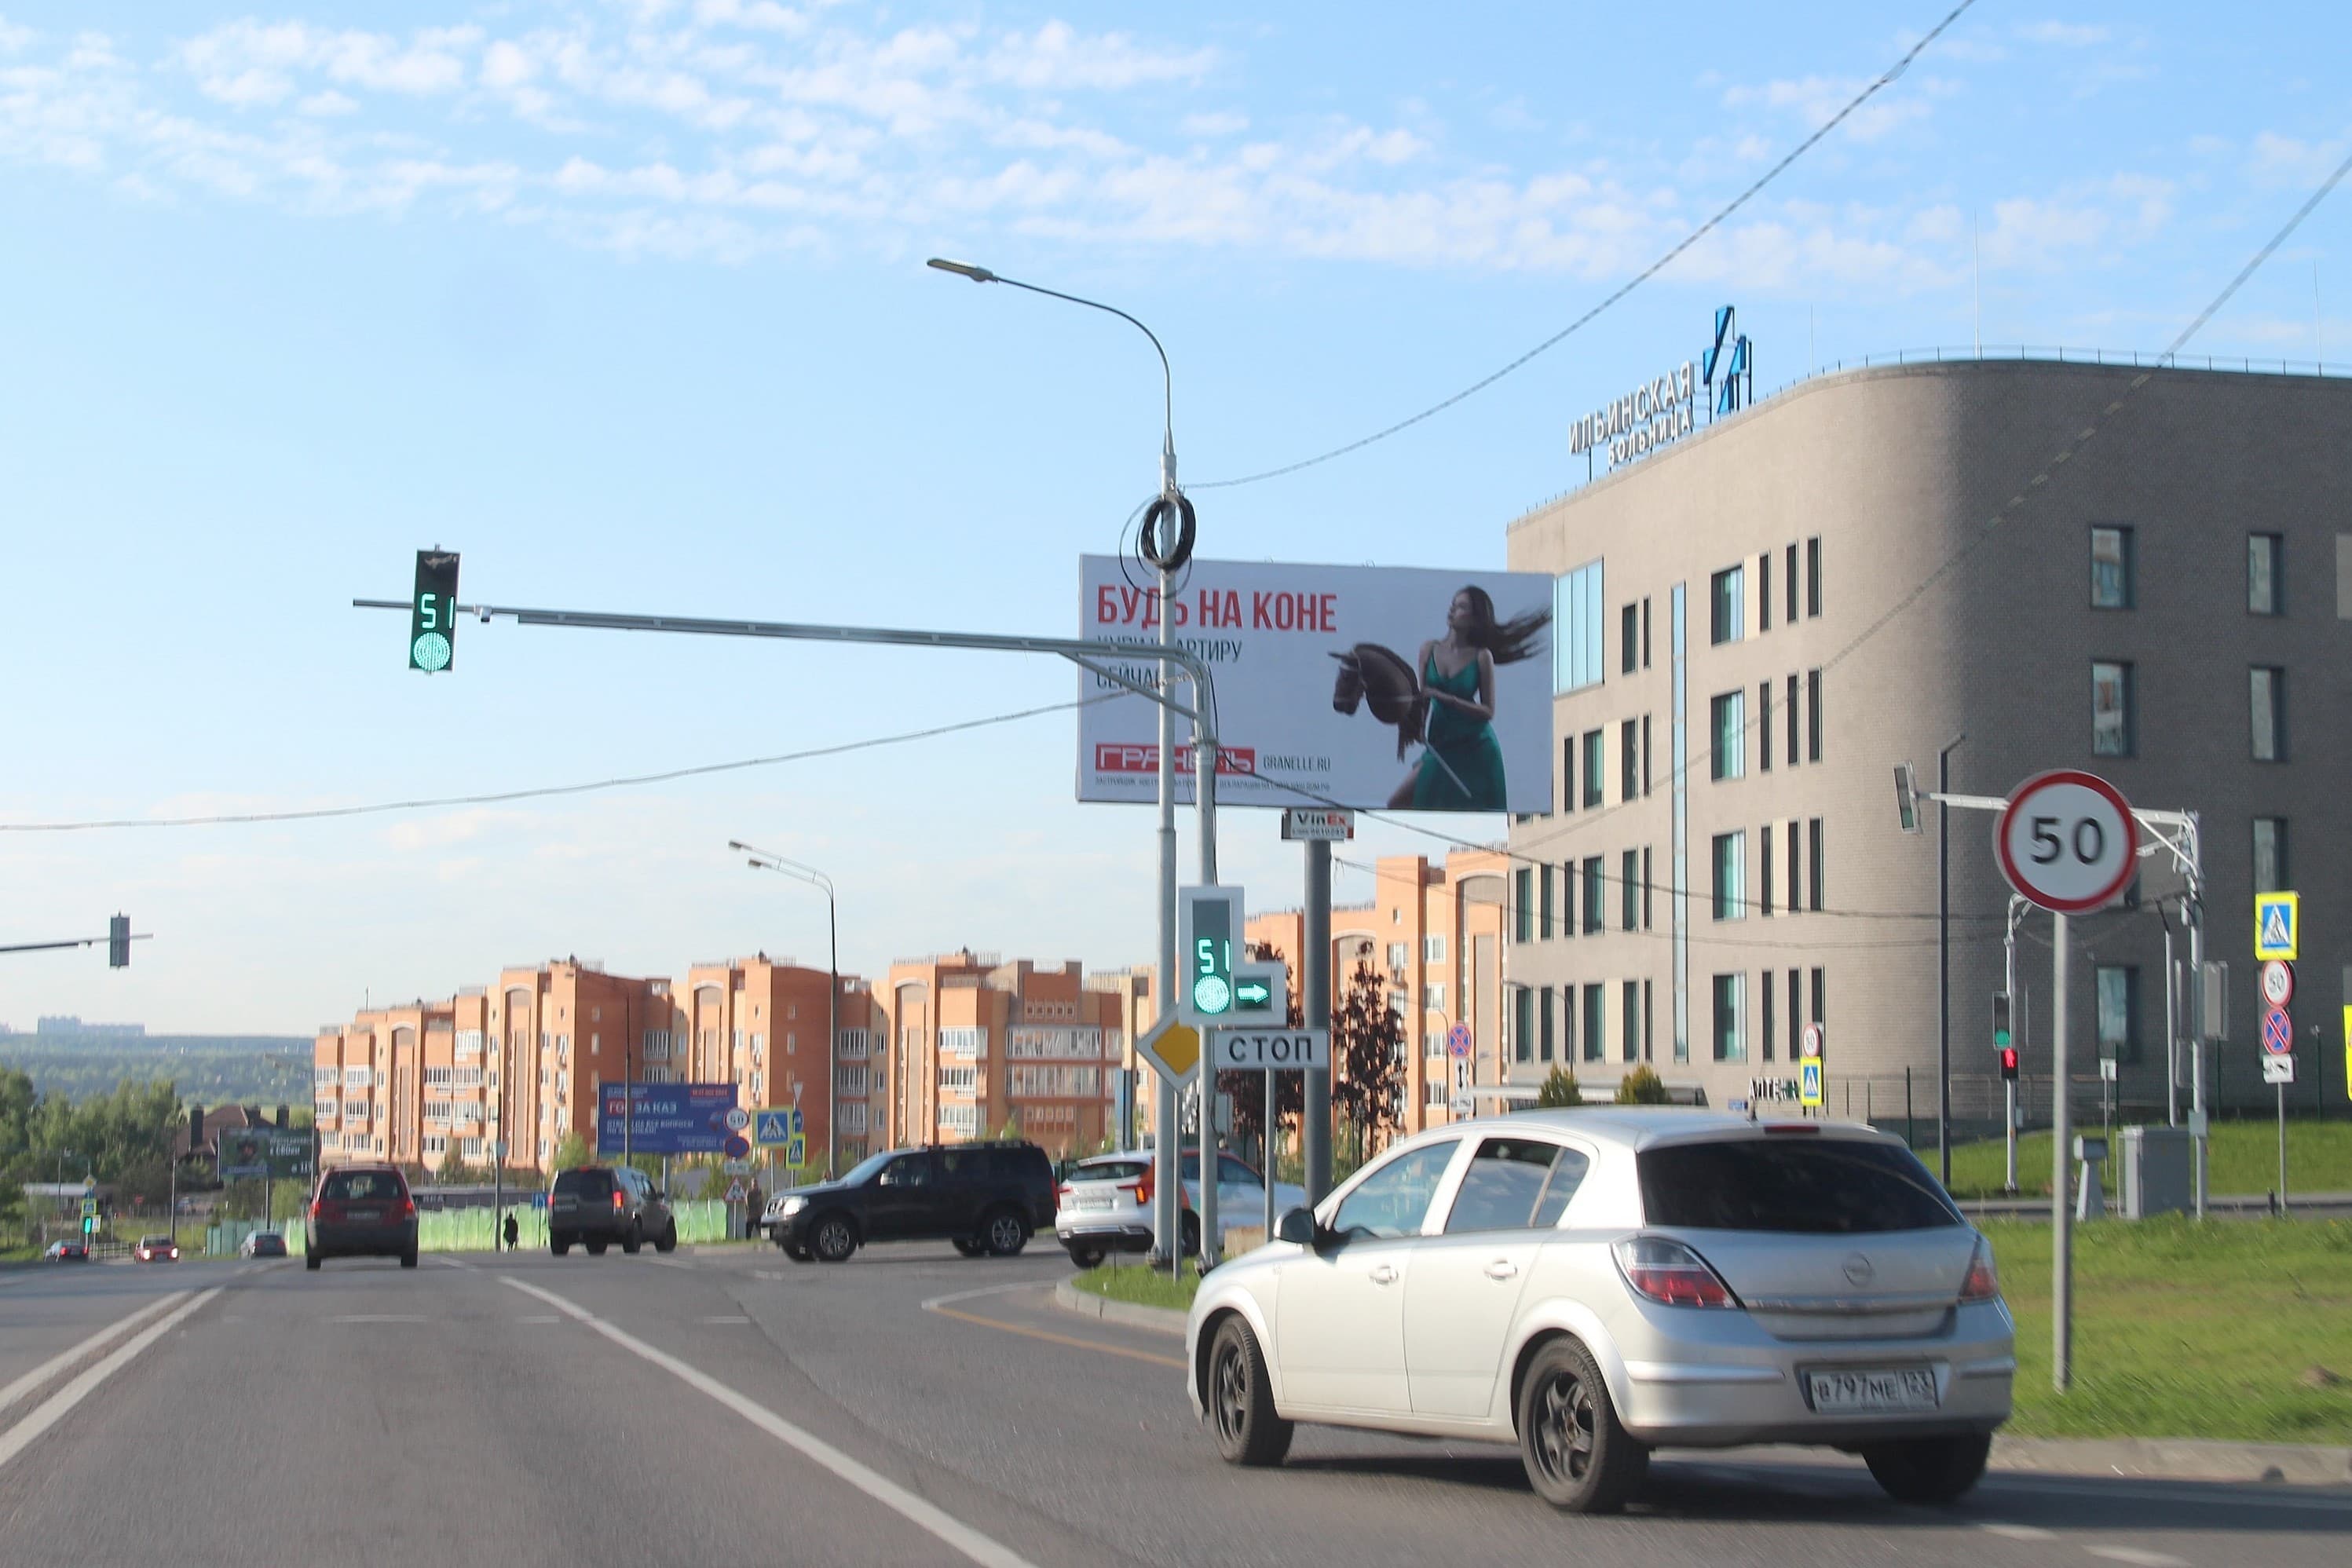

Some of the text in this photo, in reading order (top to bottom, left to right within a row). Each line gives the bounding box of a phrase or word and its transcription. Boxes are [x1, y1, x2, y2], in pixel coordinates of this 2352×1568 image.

[1569, 359, 1695, 454] ИЛЬИНСКАЯ
[1608, 405, 1691, 467] БОЛЬНИЦА
[1199, 588, 1242, 628] НА
[1253, 590, 1337, 632] КОНЕ
[1263, 754, 1331, 772] GRANELLE.RU
[1297, 812, 1346, 826] VinEx
[2030, 817, 2104, 864] 50
[1228, 1036, 1312, 1061] СТОП
